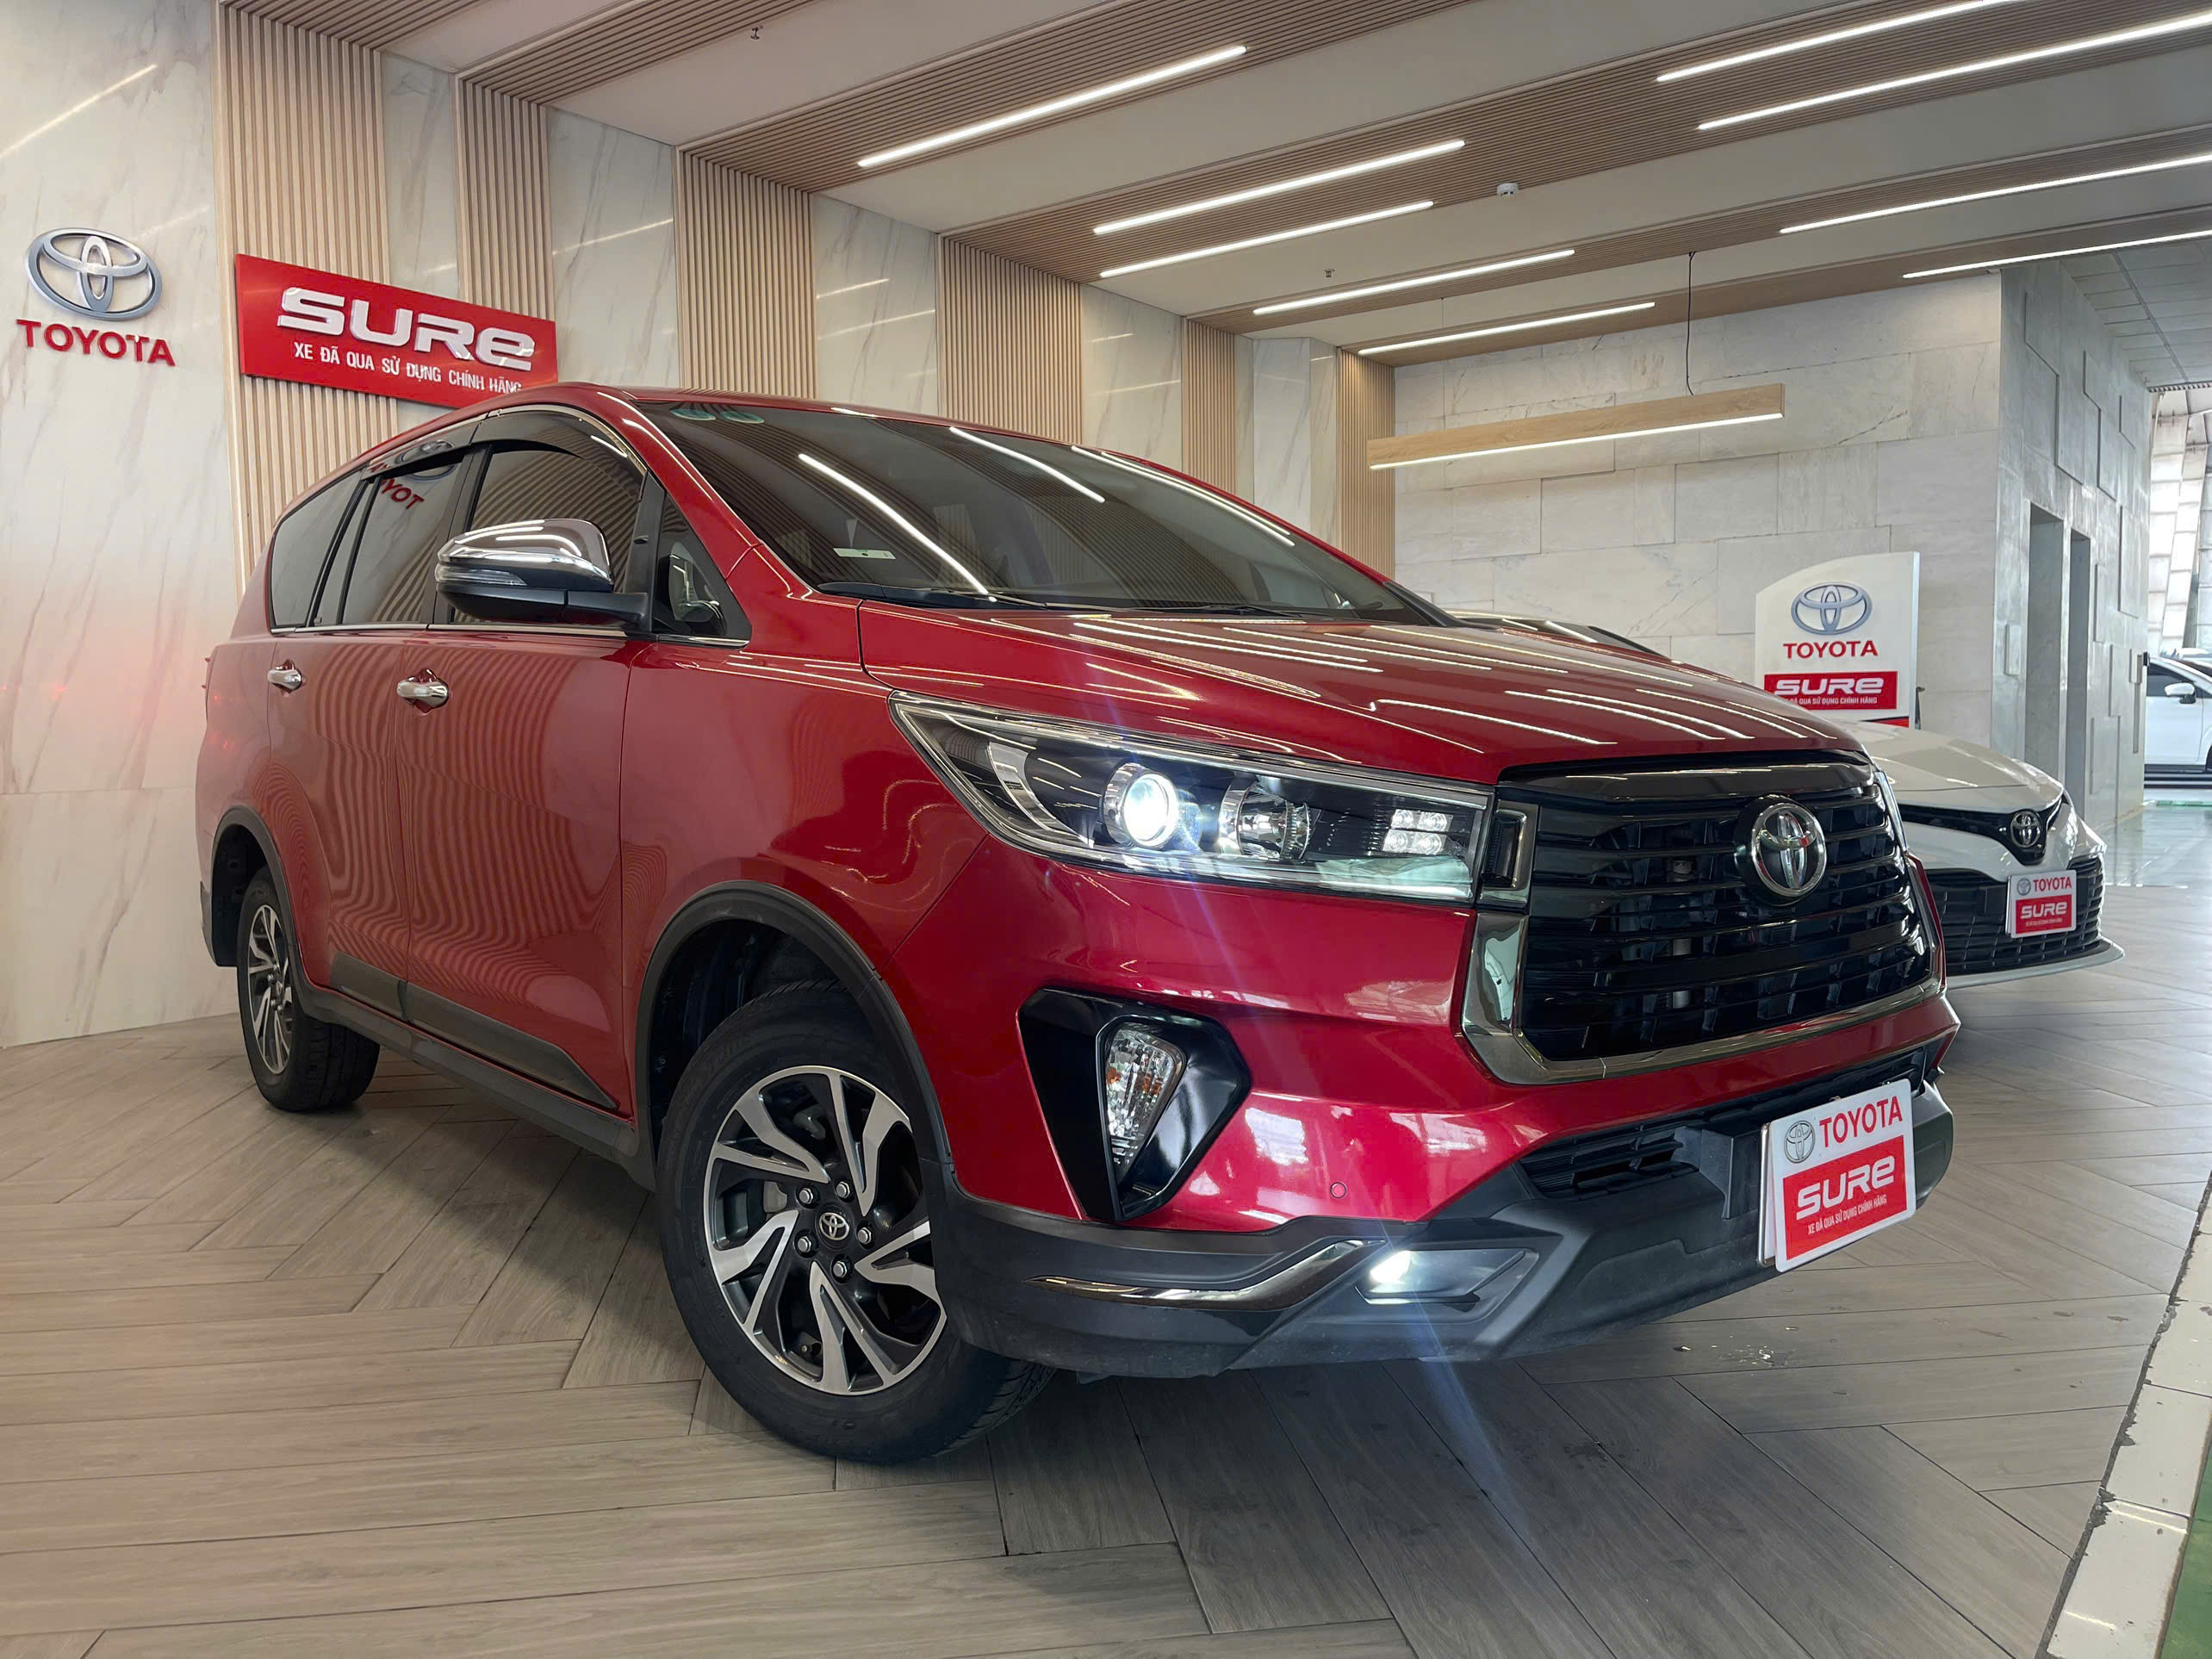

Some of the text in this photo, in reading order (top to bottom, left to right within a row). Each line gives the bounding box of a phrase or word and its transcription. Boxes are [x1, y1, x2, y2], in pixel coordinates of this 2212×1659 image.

[16, 319, 177, 367] TOYOTA
[294, 341, 313, 360] XE
[320, 345, 340, 365] ĐÃ
[346, 351, 375, 370] QUA
[382, 356, 401, 376] SỬ
[407, 363, 441, 382] DỤNG
[448, 366, 485, 391] CHÍNH
[1783, 640, 1878, 659] TOYOTA
[2033, 876, 2072, 892] TOYOTA
[1819, 1096, 1903, 1147] TOYOTA
[1808, 1223, 1816, 1234] XE
[1824, 1215, 1835, 1229] QUA
